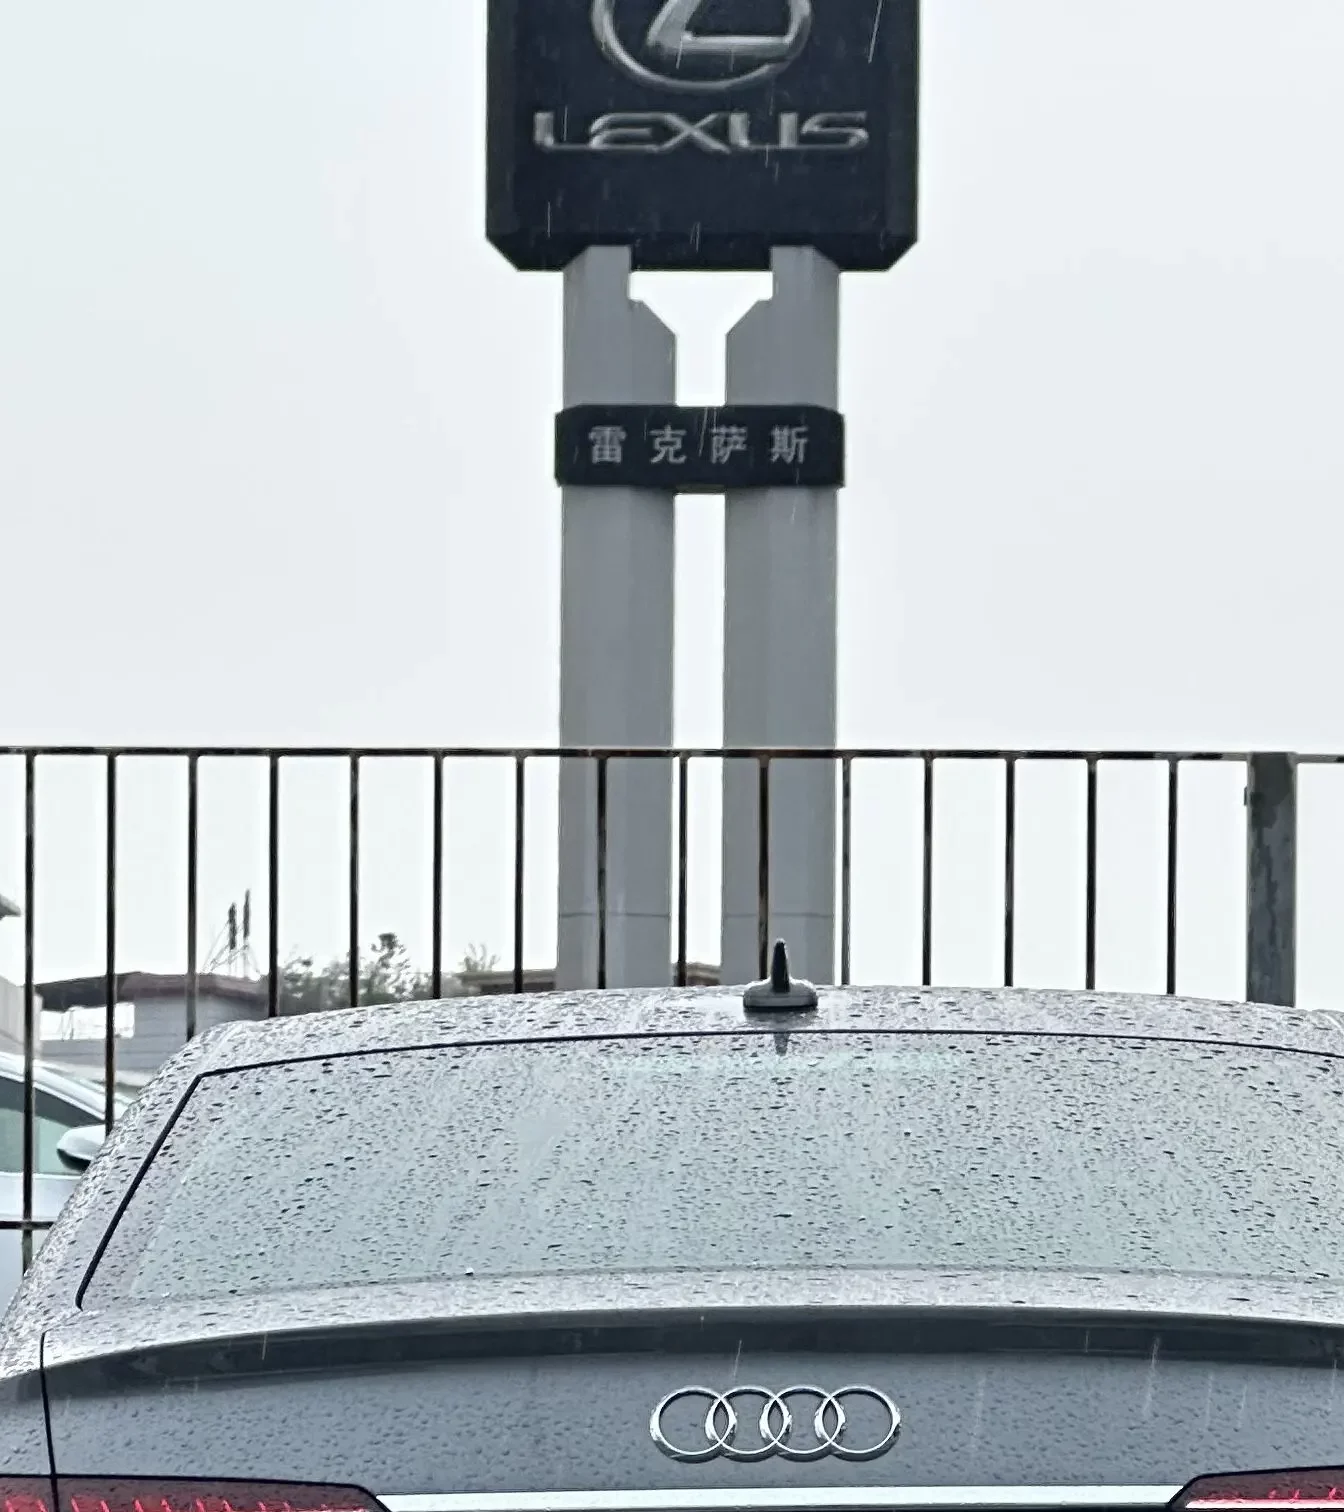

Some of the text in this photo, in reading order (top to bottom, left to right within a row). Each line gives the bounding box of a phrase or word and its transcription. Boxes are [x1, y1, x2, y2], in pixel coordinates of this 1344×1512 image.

[533, 111, 869, 153] LEXUS
[588, 425, 809, 465] 雷克萨斯
